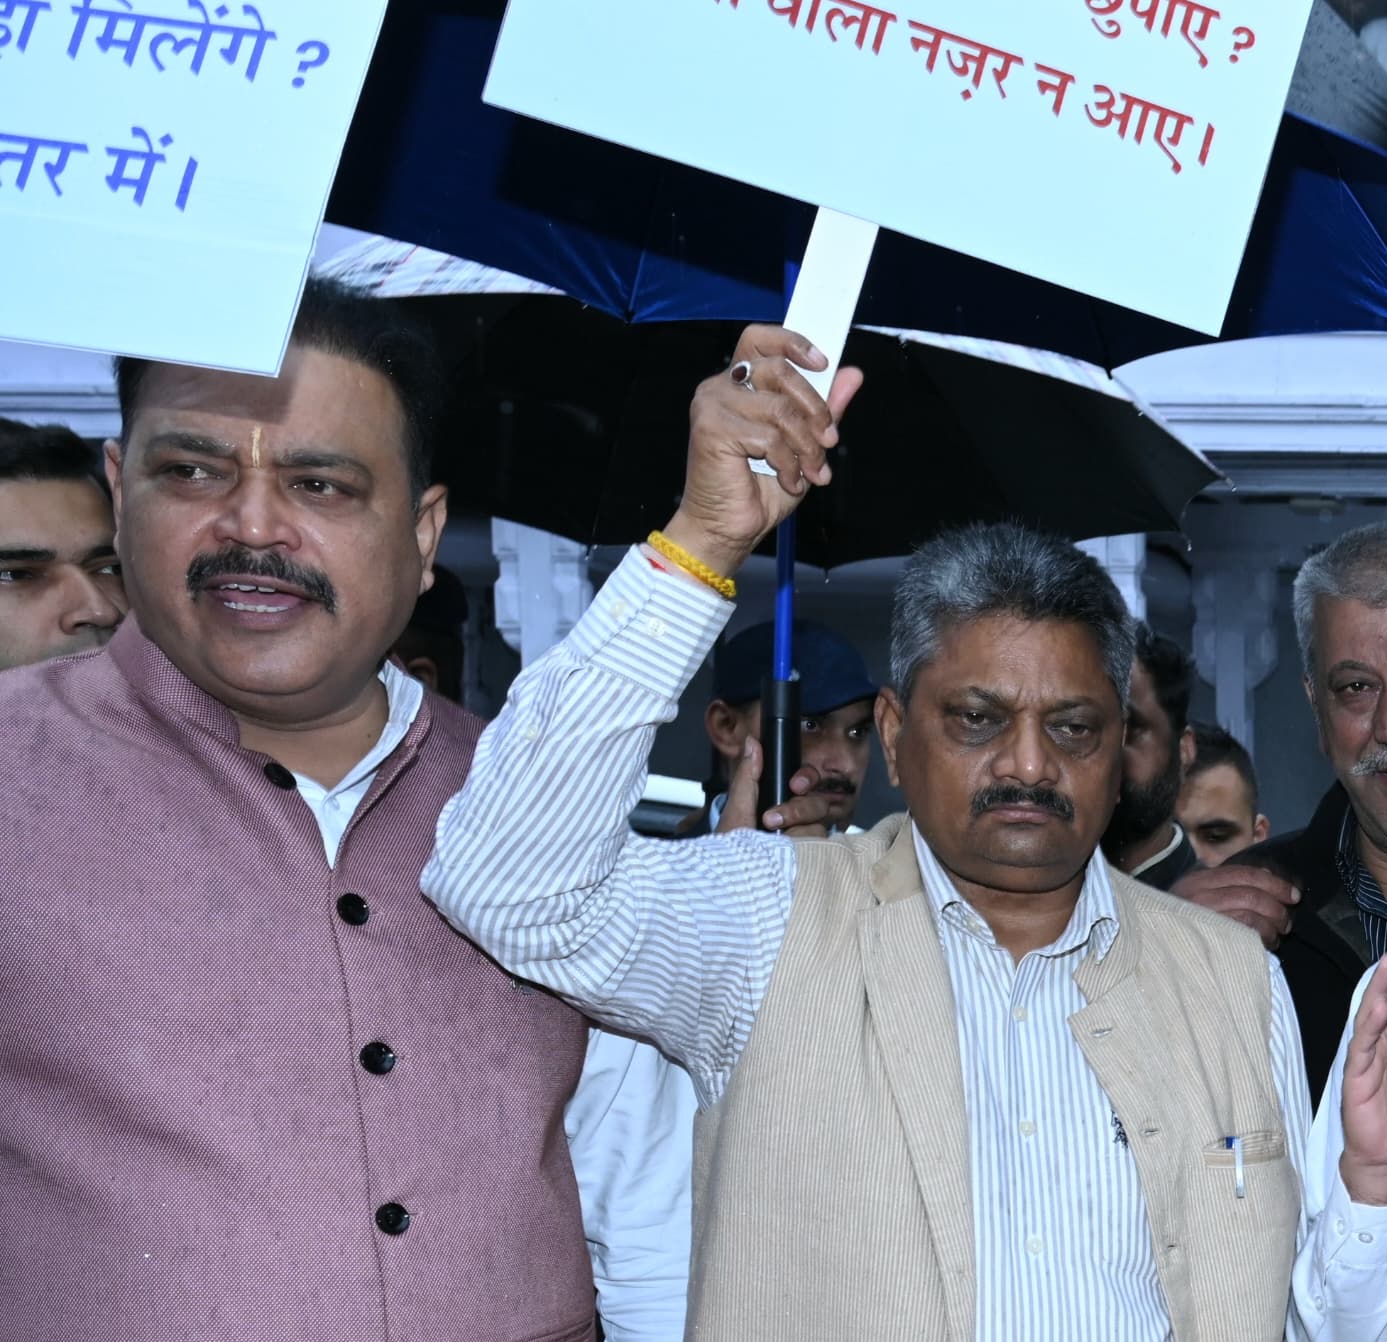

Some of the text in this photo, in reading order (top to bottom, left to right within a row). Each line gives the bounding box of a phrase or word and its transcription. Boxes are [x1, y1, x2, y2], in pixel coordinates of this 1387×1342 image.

[292, 40, 329, 88] ?
[1230, 27, 1255, 63] ?
[908, 20, 1024, 100] नज़र
[1035, 63, 1075, 116] न
[1085, 85, 1214, 174] आए।
[0, 127, 198, 211] तर में।
